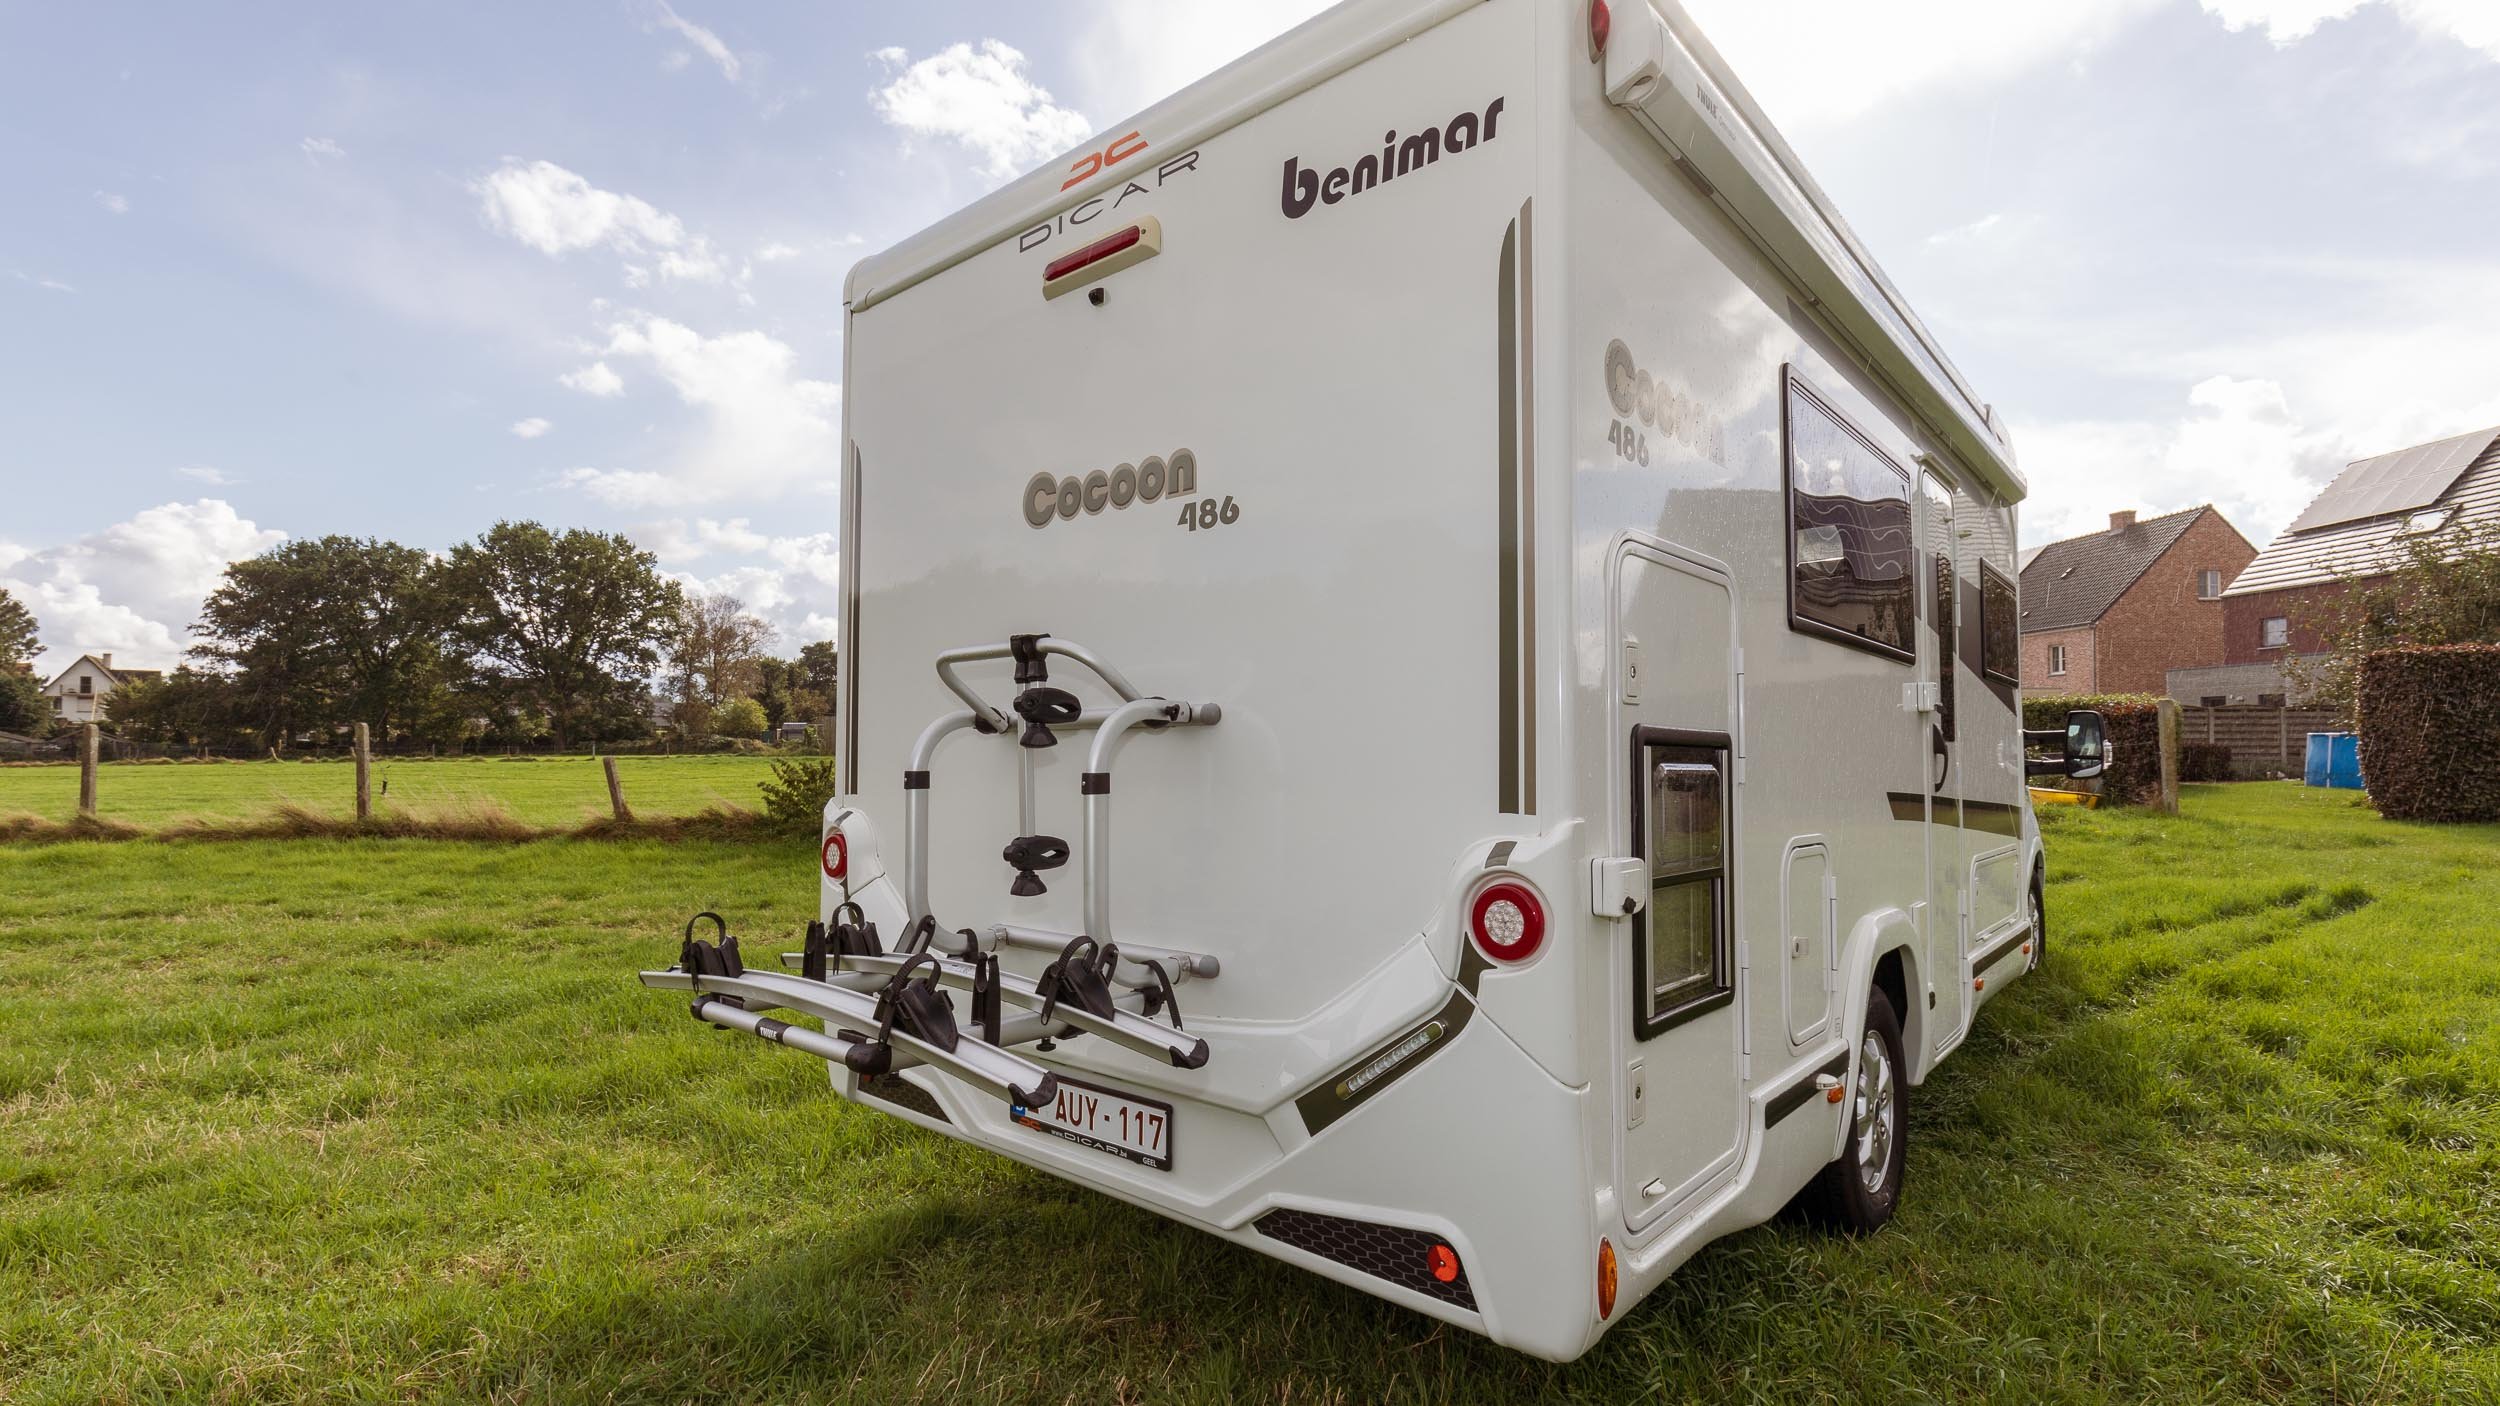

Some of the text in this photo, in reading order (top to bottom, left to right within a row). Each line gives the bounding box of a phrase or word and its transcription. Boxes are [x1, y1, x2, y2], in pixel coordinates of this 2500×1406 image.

[1281, 96, 1504, 219] benimar
[1019, 151, 1199, 253] DICAR
[1608, 418, 1649, 467] 486
[1023, 447, 1197, 530] Cocoon
[1177, 495, 1240, 532] 486
[1142, 1157, 1157, 1168] GEEL
